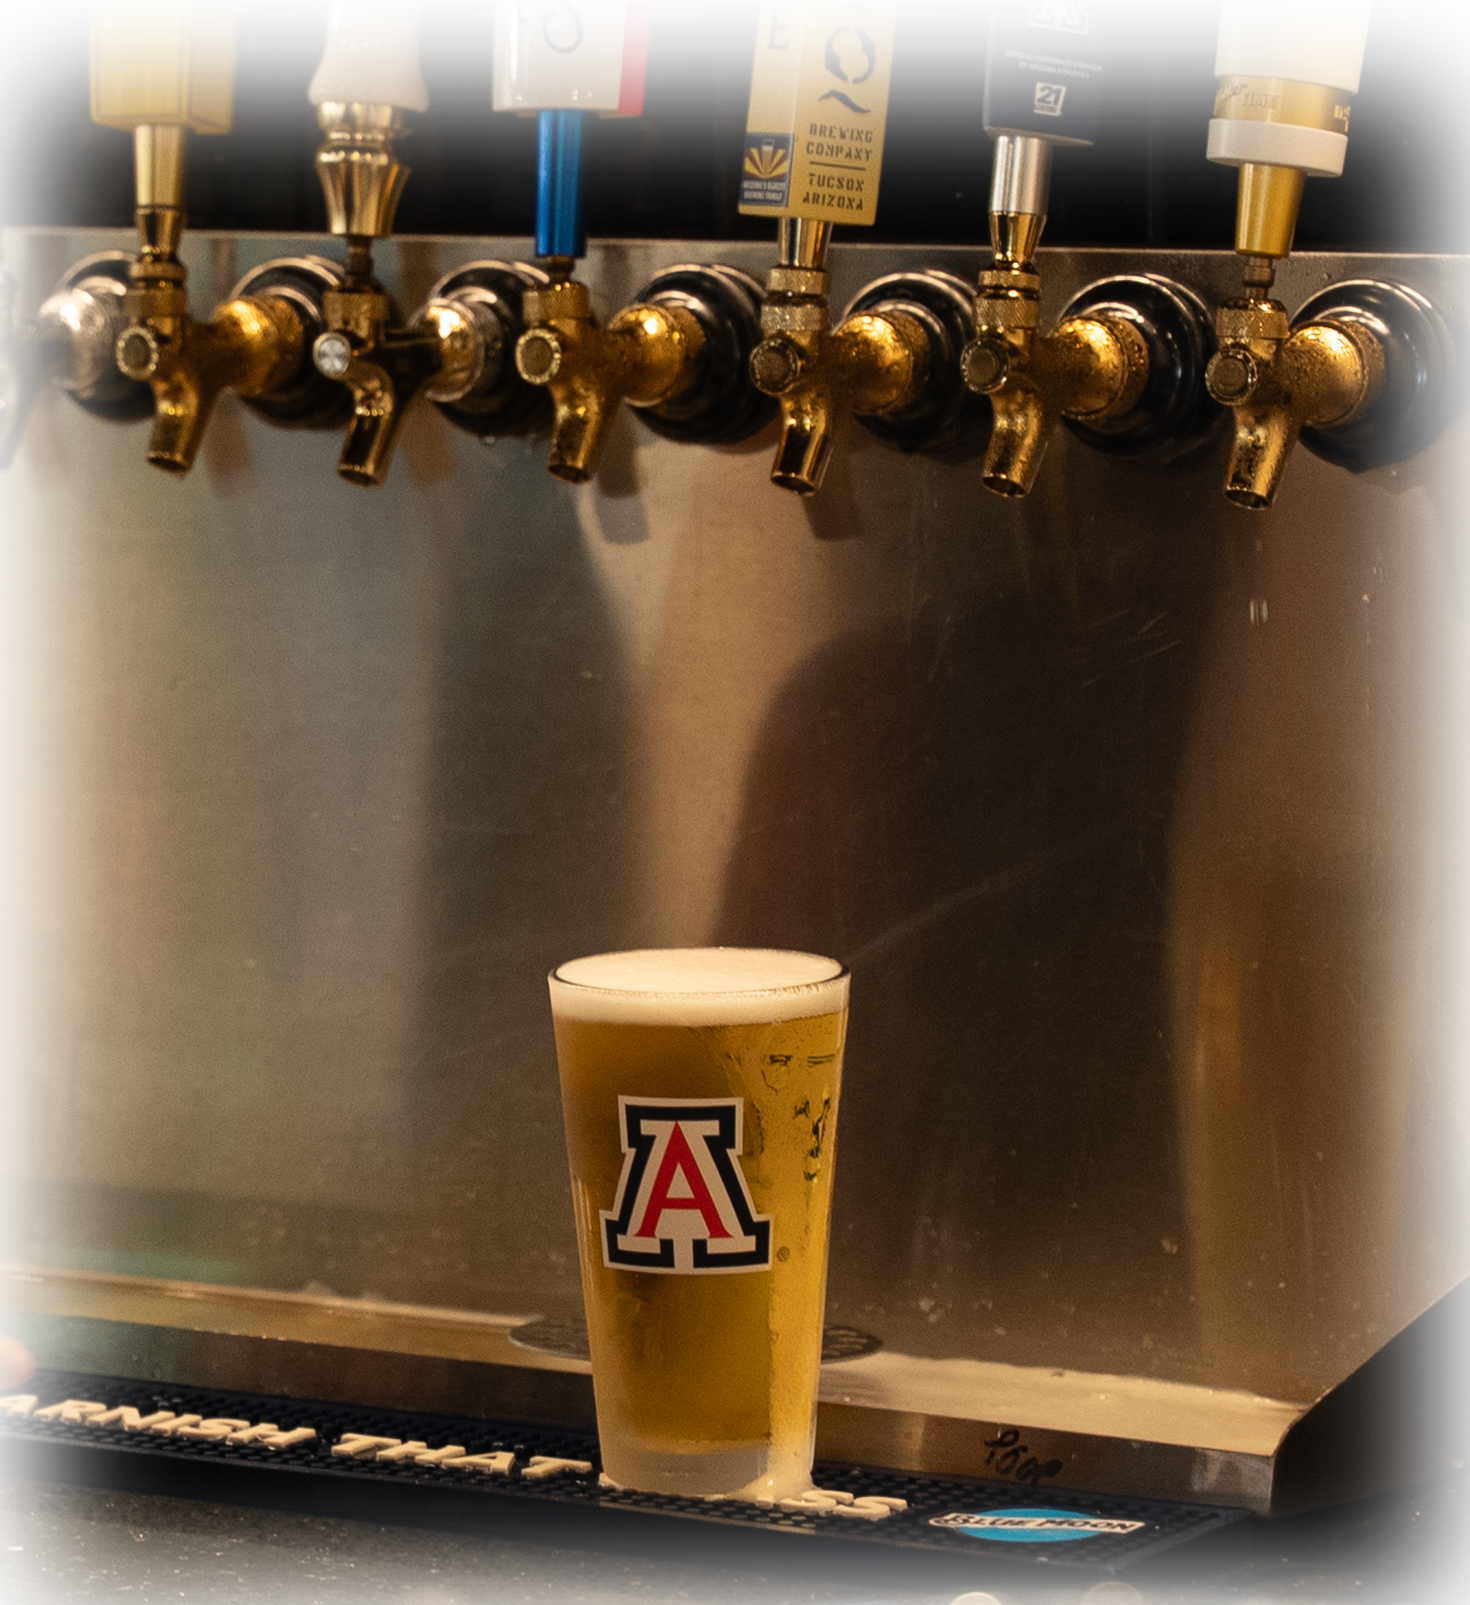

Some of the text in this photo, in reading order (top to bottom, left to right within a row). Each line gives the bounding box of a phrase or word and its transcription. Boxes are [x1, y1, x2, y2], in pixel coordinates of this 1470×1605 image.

[1005, 49, 1103, 72] OFFICIAL CORPORATE SPONSOR
[1018, 61, 1090, 79] OF ARIZONA ATHLETICS
[1036, 85, 1063, 106] 21
[809, 122, 874, 144] BREWING
[806, 141, 873, 162] COMPANY
[807, 172, 865, 192] TUCSON
[802, 191, 864, 211] ARIZONA
[599, 1094, 773, 1275] A
[331, 1432, 593, 1479] THAT
[934, 1512, 1135, 1532] BLUE MOON
